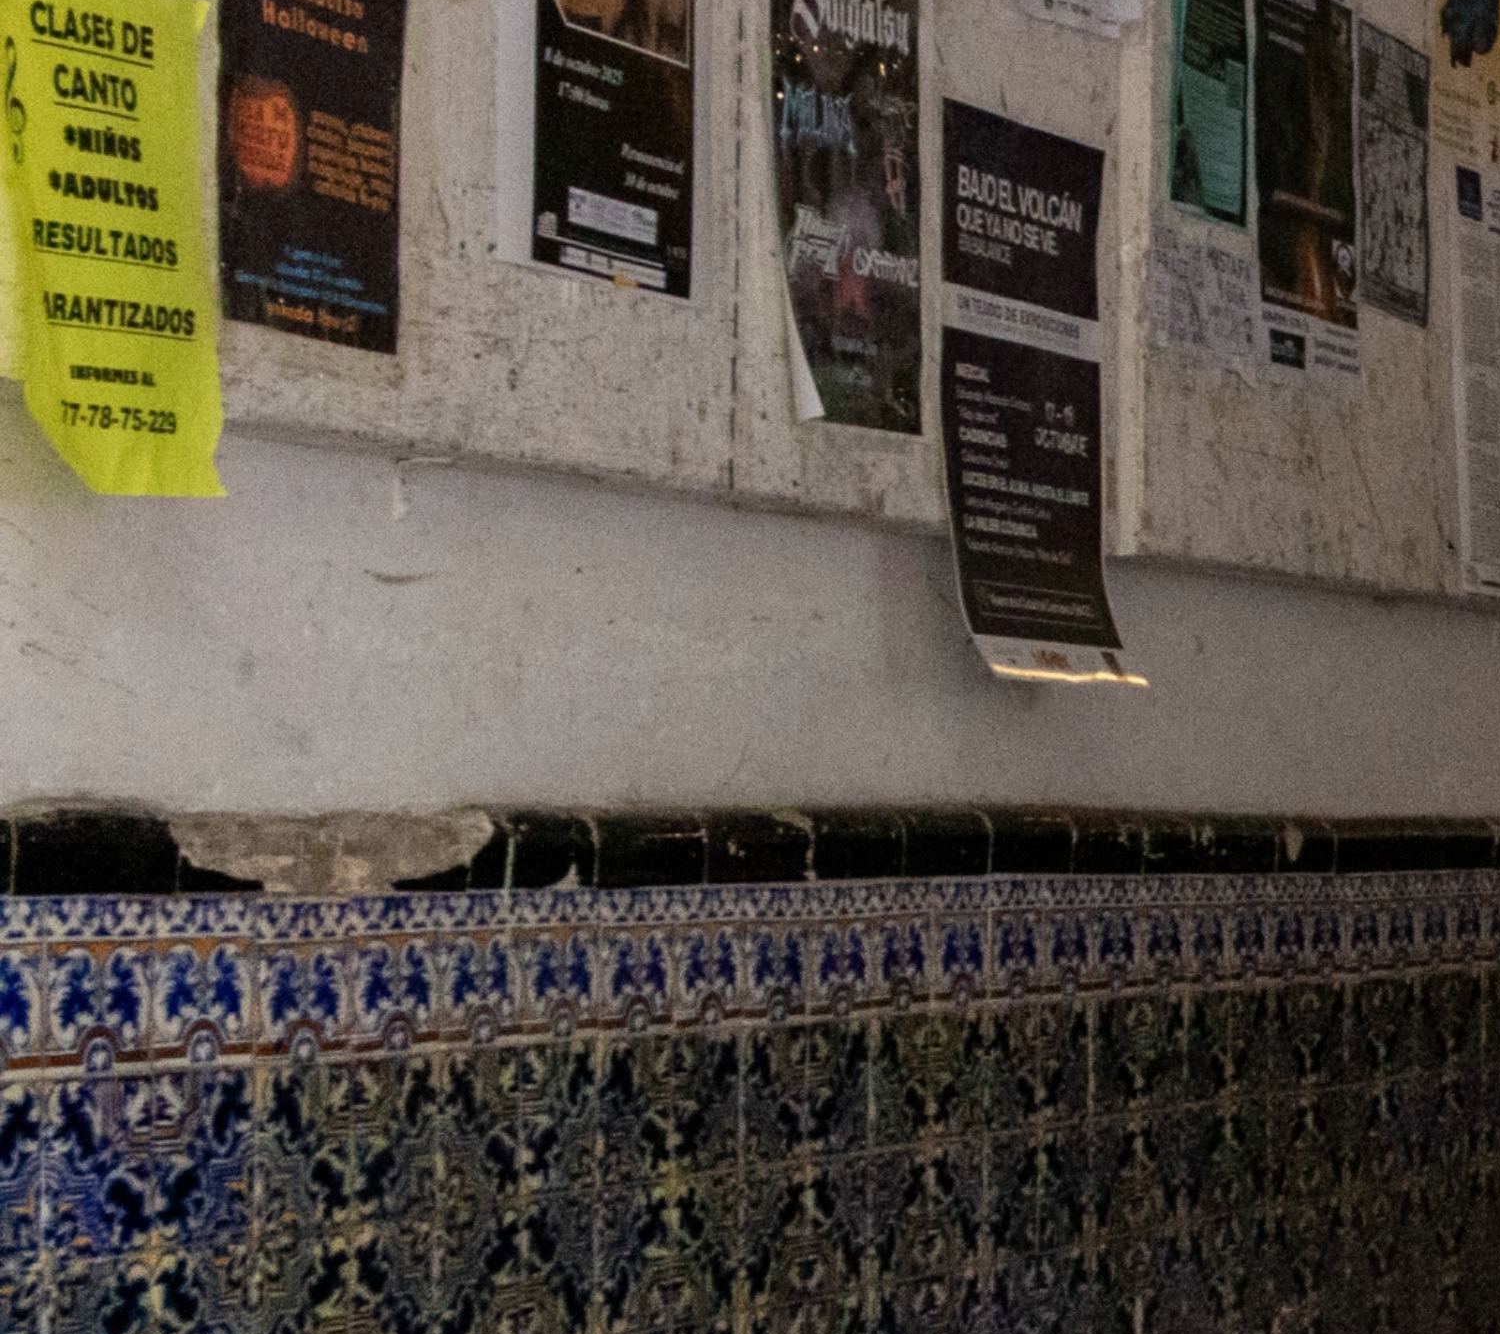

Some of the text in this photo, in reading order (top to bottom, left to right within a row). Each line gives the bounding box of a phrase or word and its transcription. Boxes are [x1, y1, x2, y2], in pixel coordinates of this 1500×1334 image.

[30, 0, 155, 60] CLASES DE
[54, 63, 138, 113] CANTO
[956, 162, 1082, 234] BAJO EL VOLCÁN
[33, 218, 178, 267] RESULTADOS
